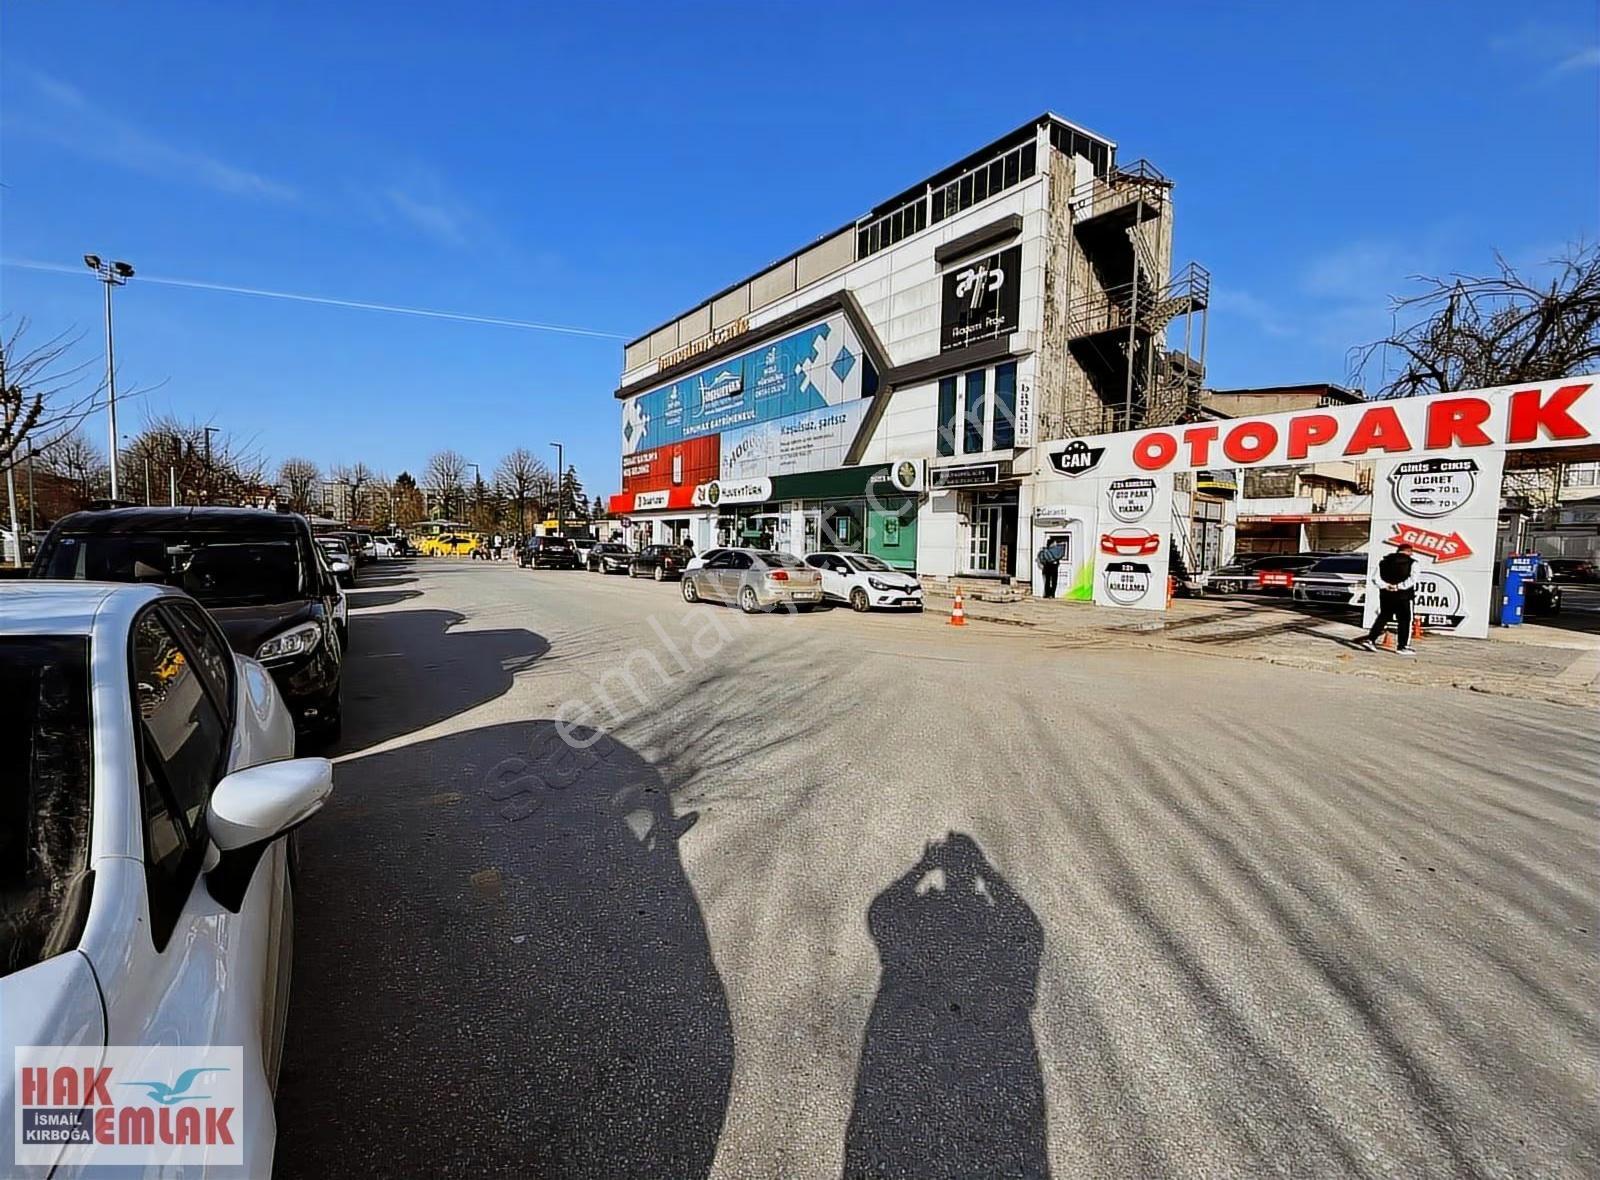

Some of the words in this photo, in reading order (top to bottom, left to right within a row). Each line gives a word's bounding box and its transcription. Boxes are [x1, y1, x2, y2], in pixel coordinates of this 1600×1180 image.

[1132, 384, 1593, 471] OTOPARK
[1061, 452, 1092, 468] CAN
[1414, 475, 1454, 485] ÜCRET
[1130, 490, 1148, 498] PARK
[1413, 595, 1449, 608] AMA
